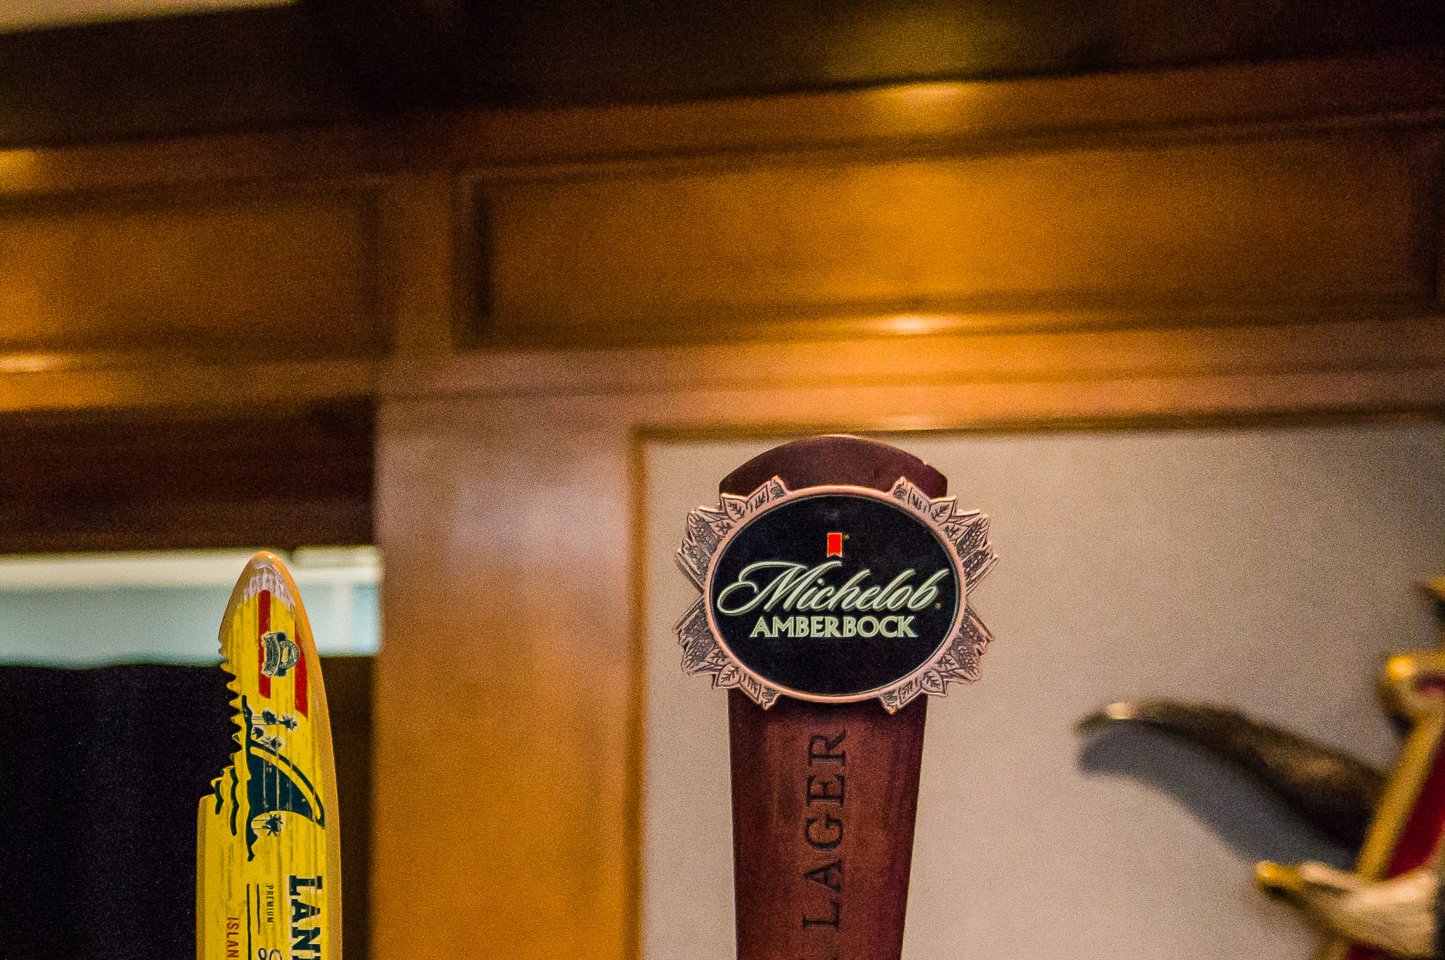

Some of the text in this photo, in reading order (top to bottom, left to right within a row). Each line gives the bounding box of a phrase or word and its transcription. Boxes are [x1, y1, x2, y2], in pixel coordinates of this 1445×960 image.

[716, 560, 949, 616] Michelob
[749, 615, 919, 638] AMBERBOCK
[802, 729, 846, 930] LAGER
[265, 884, 275, 923] PREMIUM
